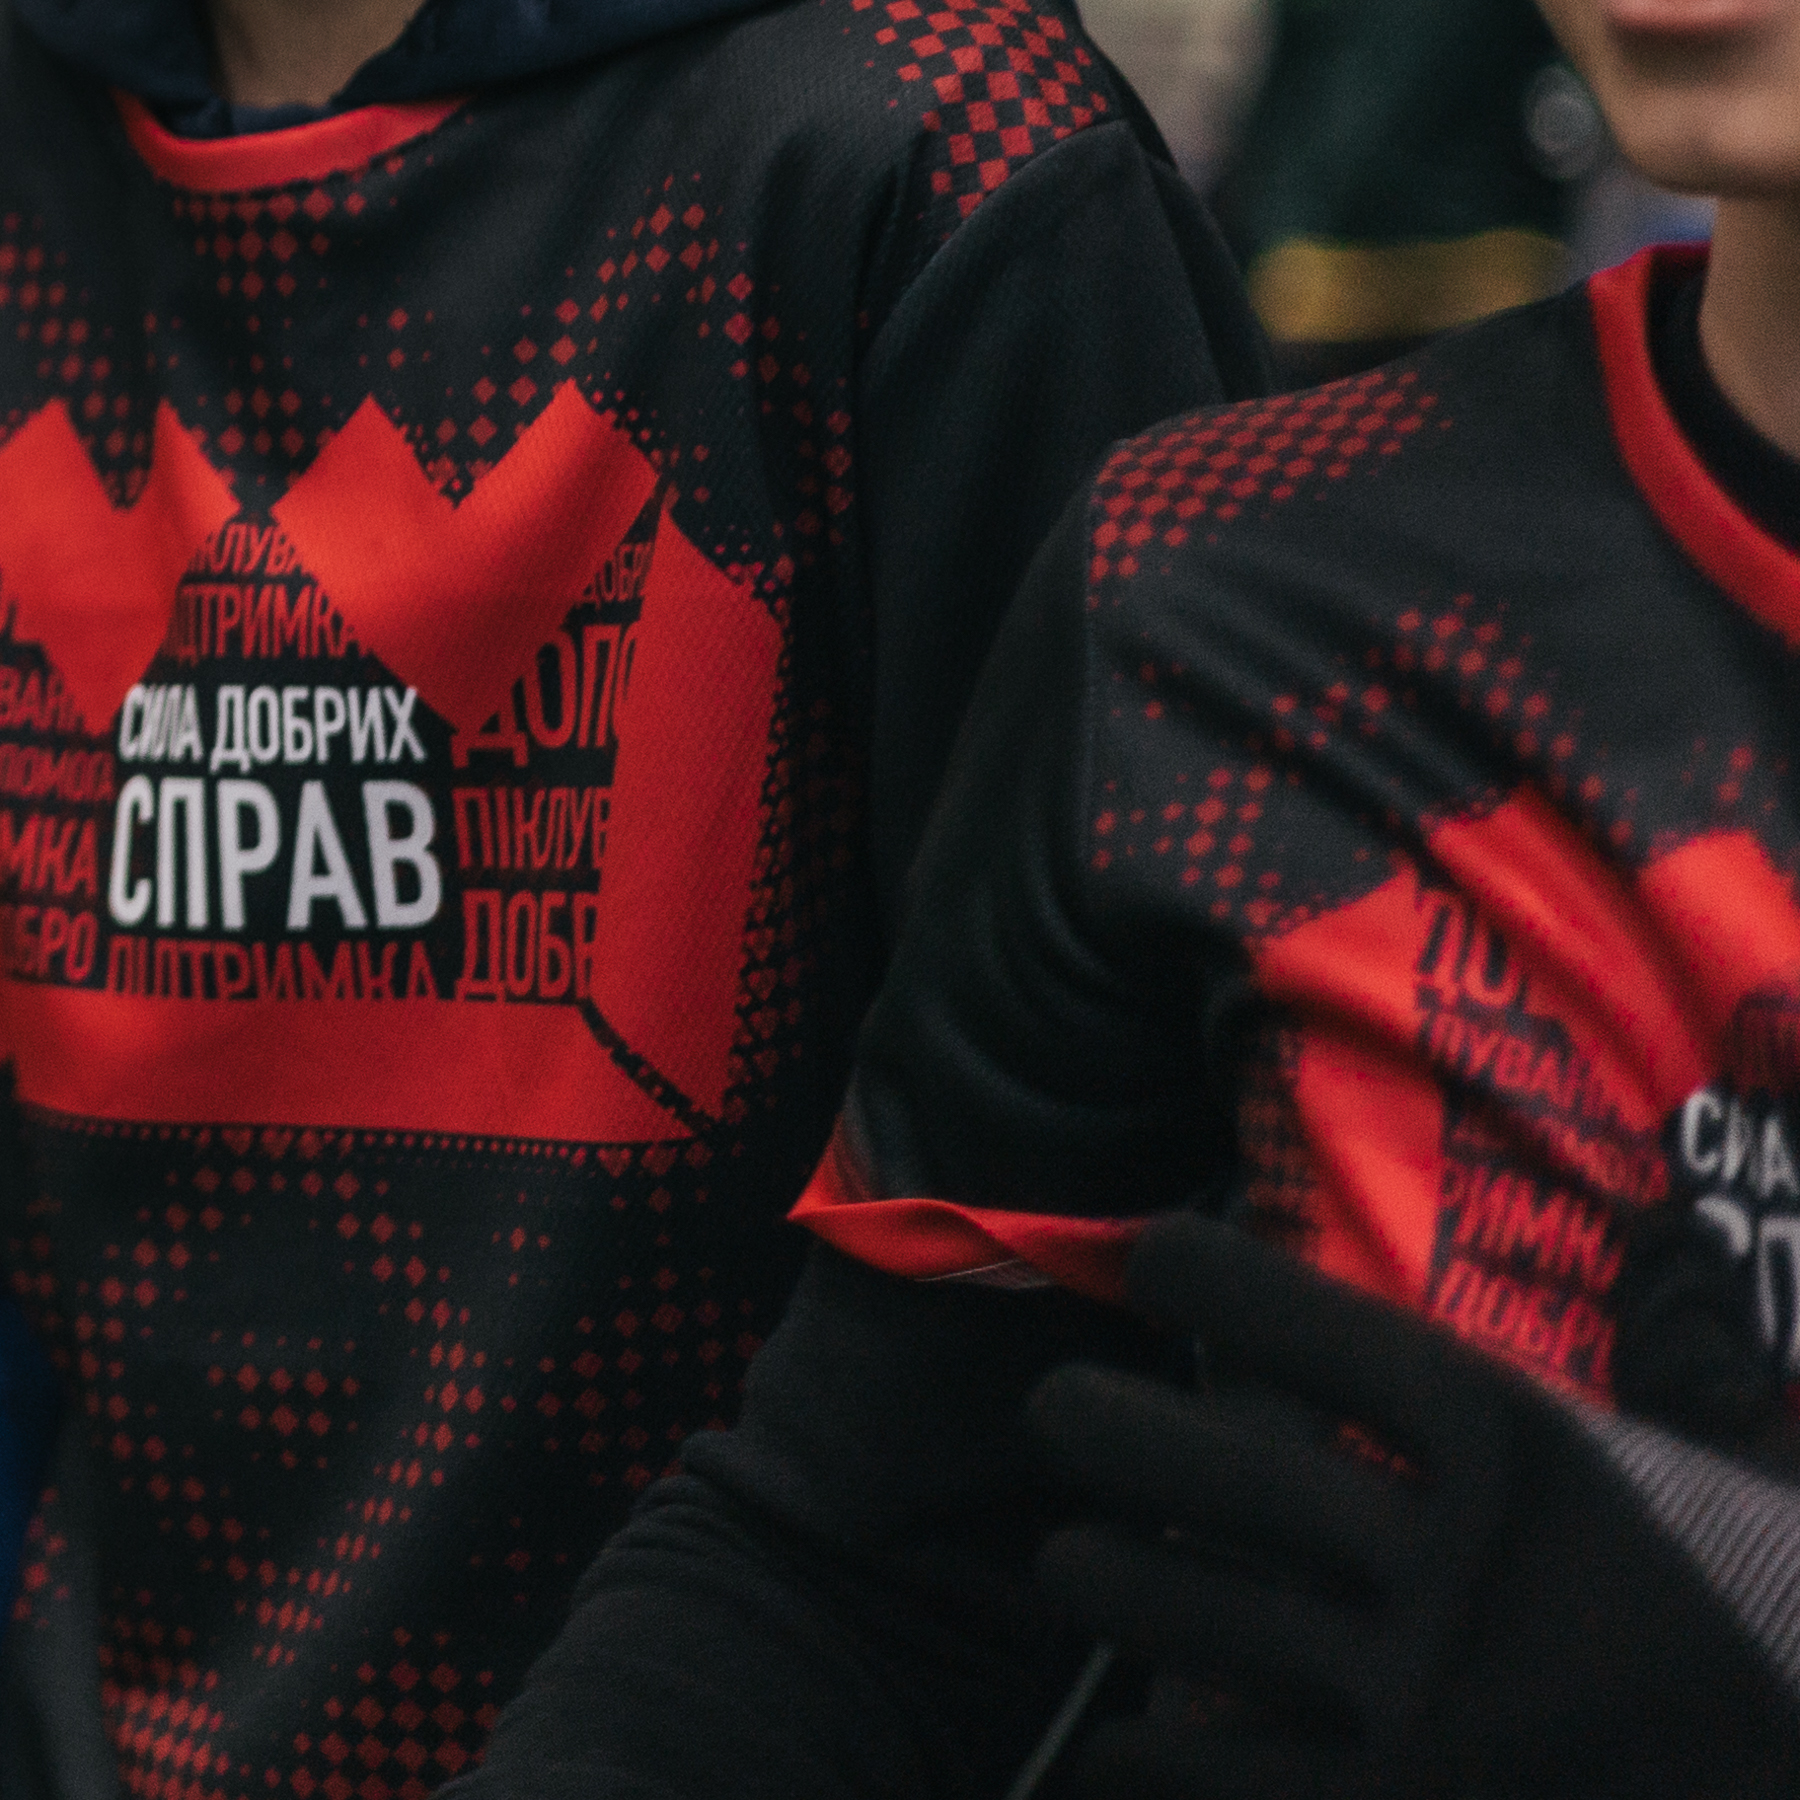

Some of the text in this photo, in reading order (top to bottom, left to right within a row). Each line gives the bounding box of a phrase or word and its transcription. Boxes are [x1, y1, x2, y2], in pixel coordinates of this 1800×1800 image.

[119, 683, 427, 776] СИЛА ДОБРИХ
[108, 773, 443, 930] СПРАВ
